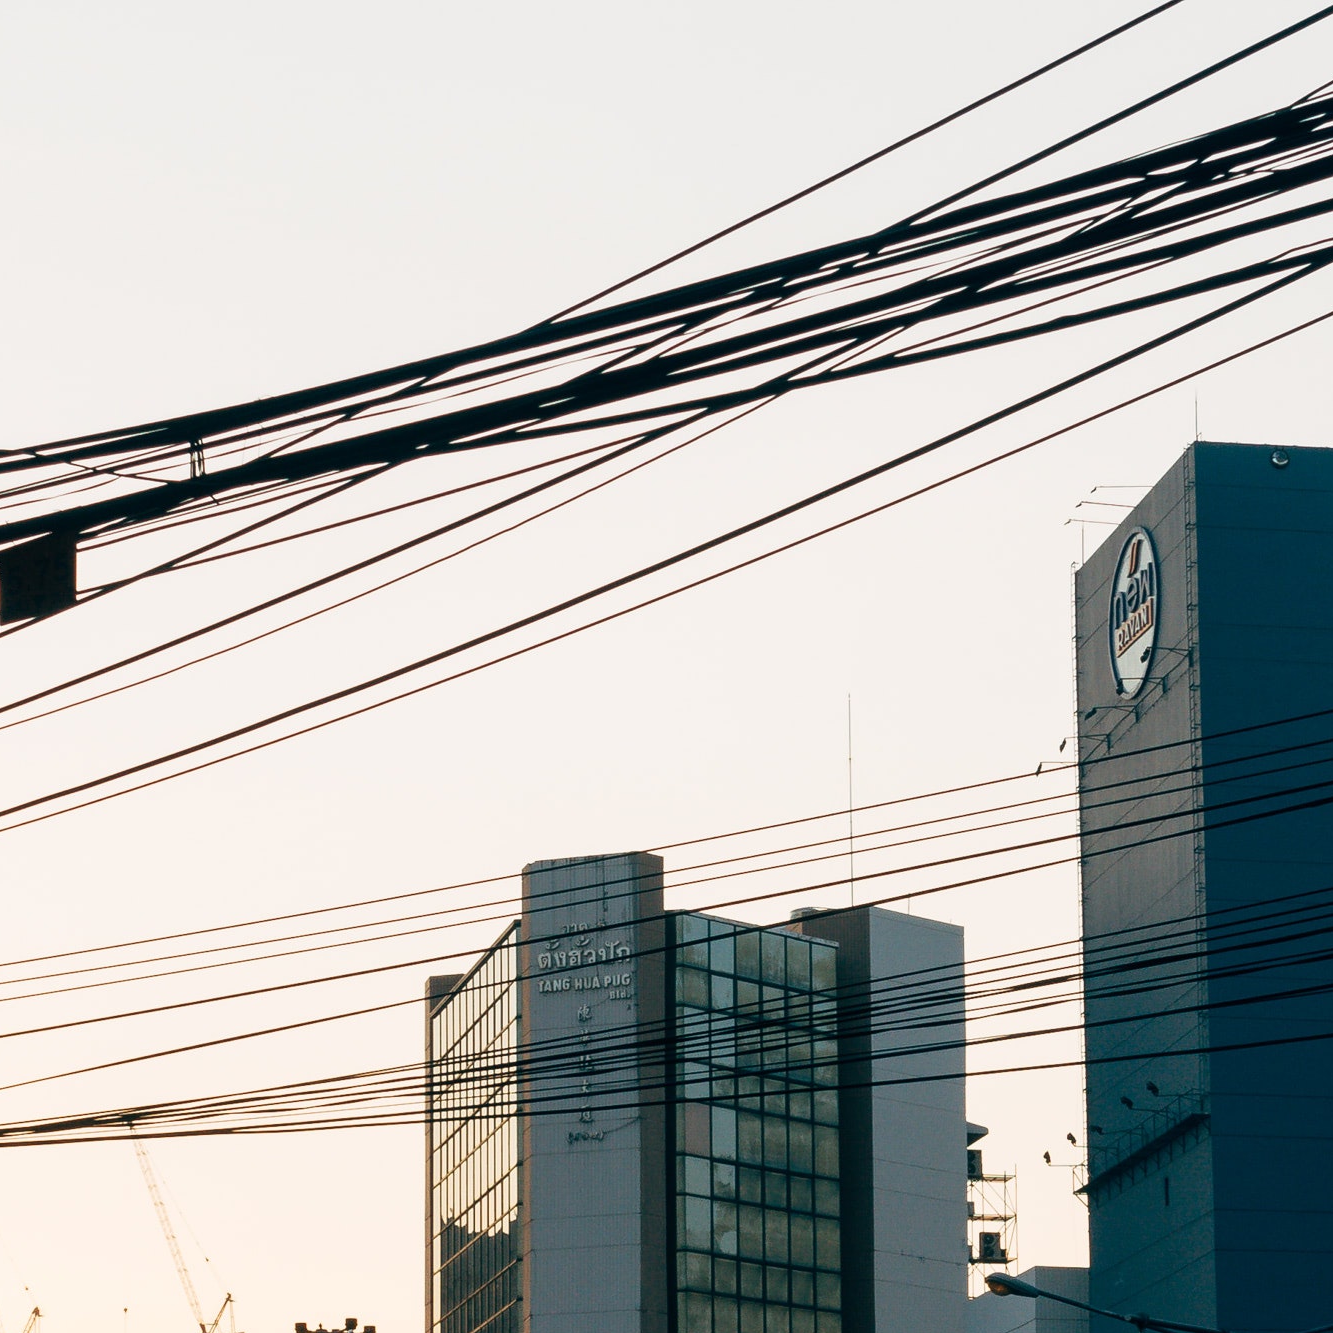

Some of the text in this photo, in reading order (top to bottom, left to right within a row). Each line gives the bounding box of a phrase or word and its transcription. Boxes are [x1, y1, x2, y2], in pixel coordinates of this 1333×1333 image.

[1114, 562, 1154, 628] new
[537, 973, 631, 993] TANG HUA PUG
